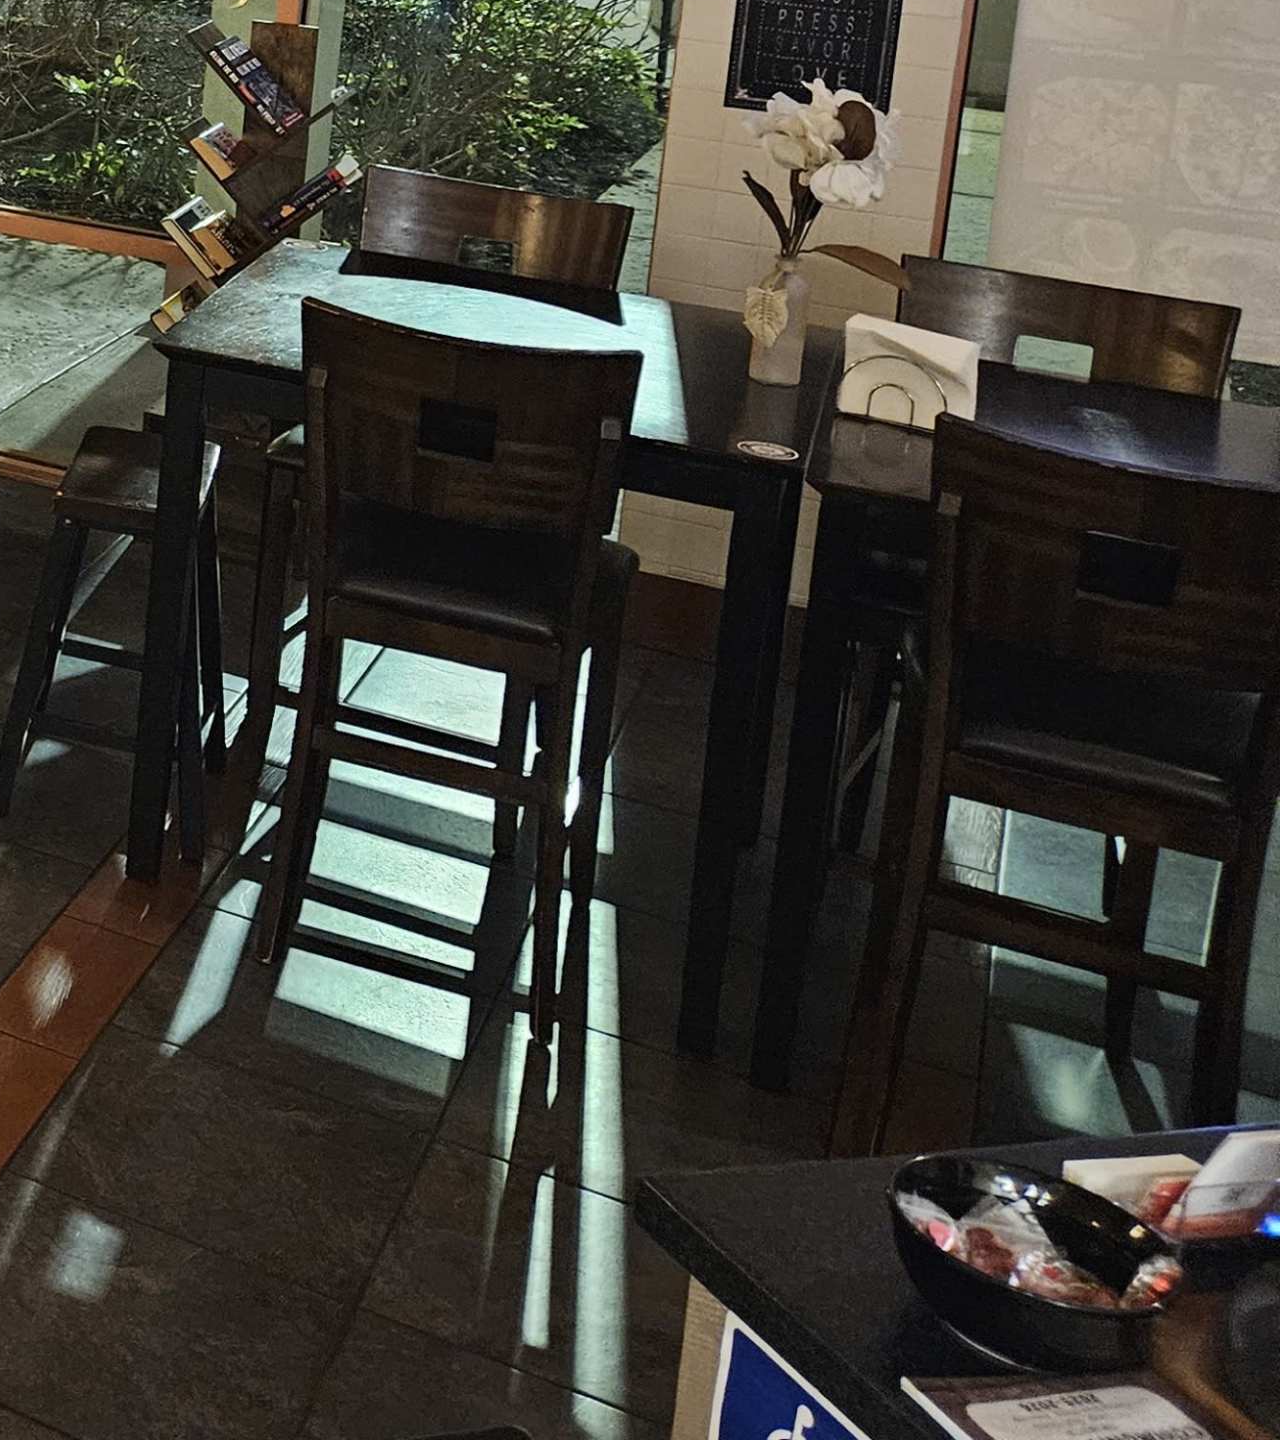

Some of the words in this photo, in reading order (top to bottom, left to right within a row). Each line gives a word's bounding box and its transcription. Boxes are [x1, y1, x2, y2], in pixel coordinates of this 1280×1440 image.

[778, 8, 856, 34] PRESS
[775, 36, 851, 60] SAVOR
[772, 64, 847, 88] LOVE
